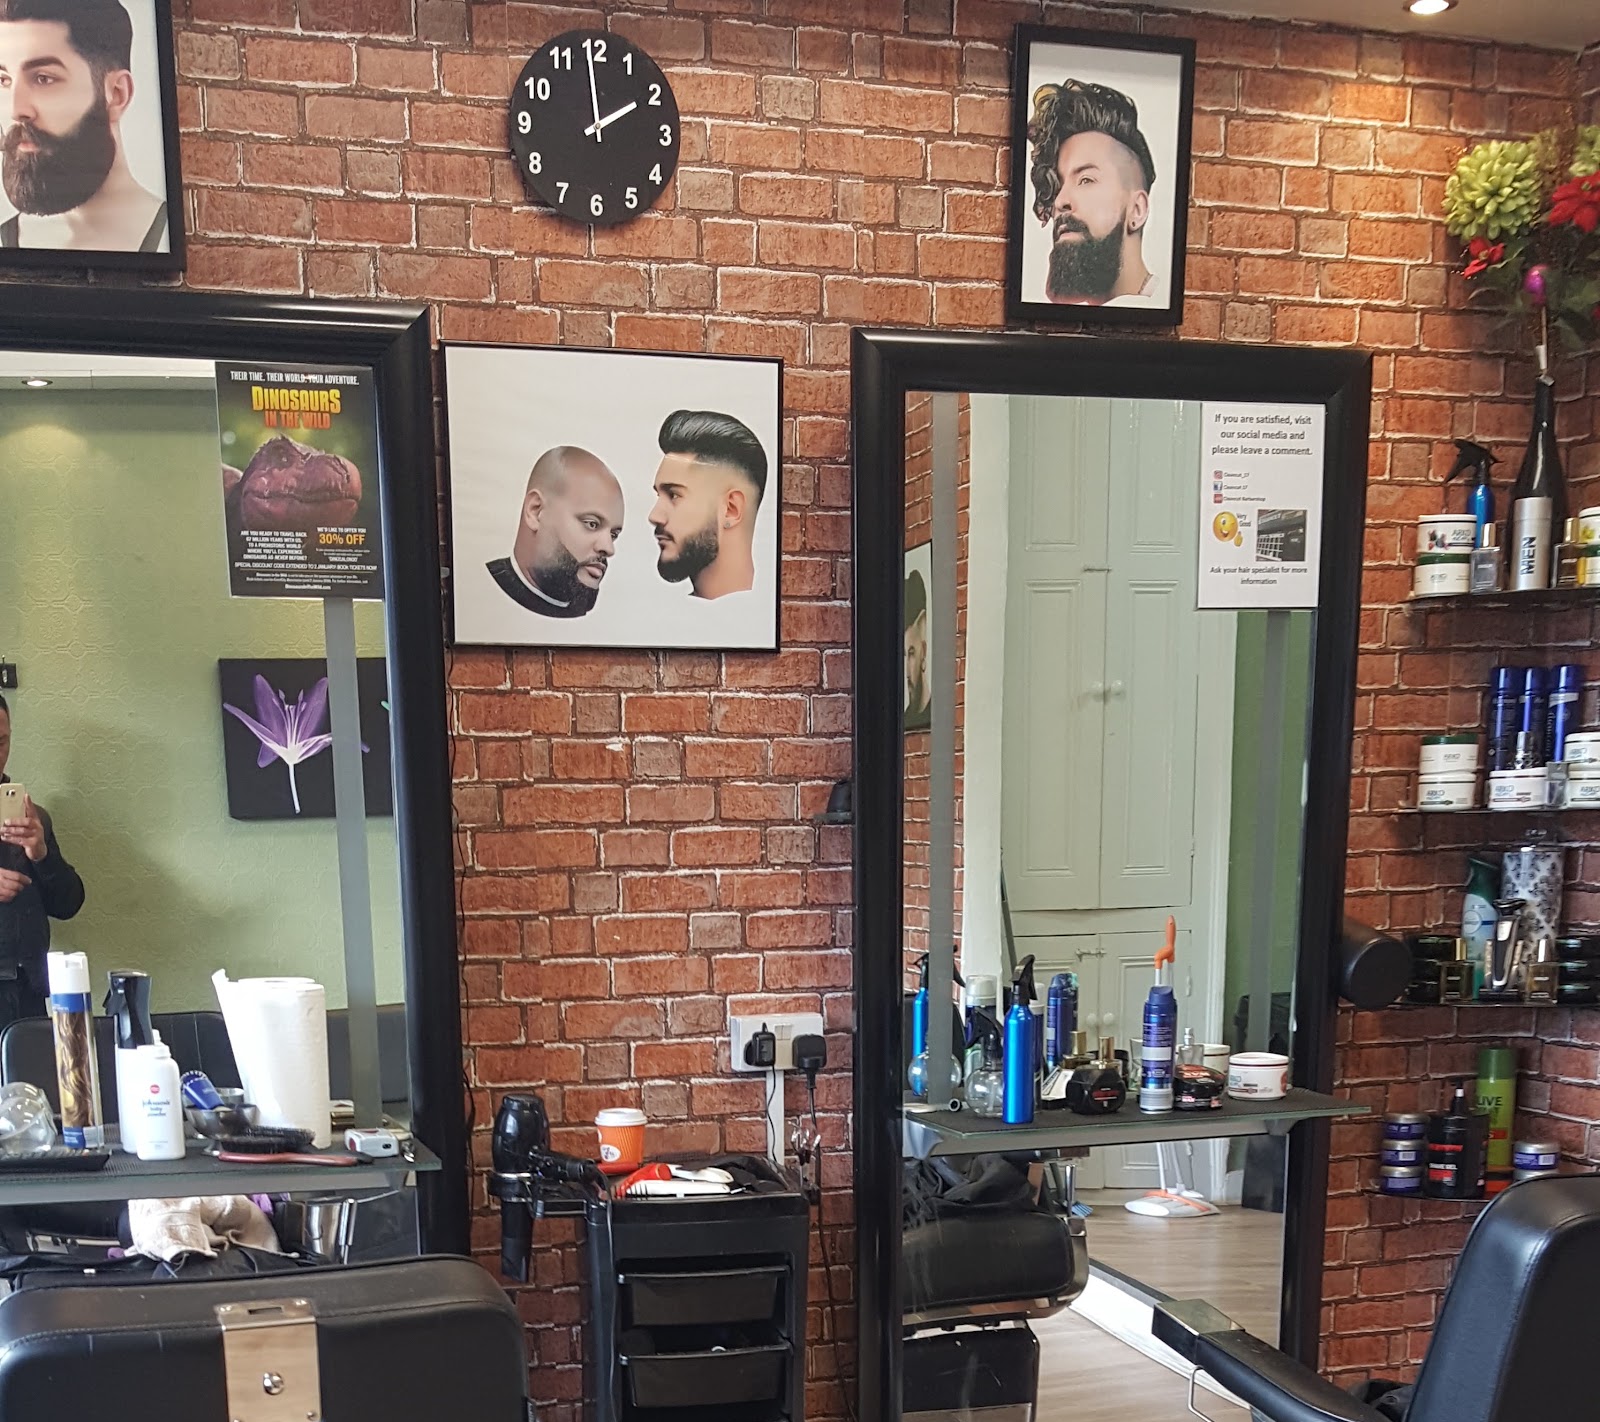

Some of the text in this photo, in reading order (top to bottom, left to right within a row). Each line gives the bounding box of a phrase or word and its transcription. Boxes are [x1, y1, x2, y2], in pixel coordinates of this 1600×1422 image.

[549, 46, 572, 70] 11
[581, 38, 607, 63] 12
[622, 53, 633, 75] 1
[525, 77, 550, 101] 10
[648, 84, 661, 106] 2
[517, 111, 532, 134] 9
[659, 125, 672, 146] 3
[528, 152, 542, 174] 8
[649, 164, 662, 185] 4
[556, 182, 569, 204] 7
[625, 187, 638, 209] 5
[590, 194, 603, 217] 6
[230, 371, 248, 380] THEIR
[248, 372, 265, 381] TIME.
[266, 372, 284, 382] THEIR
[324, 375, 359, 385] ADVENTURE.
[251, 385, 341, 414] DINOSAURS
[265, 410, 331, 429] IN THE WILD
[1214, 414, 1221, 422] If
[1223, 416, 1238, 424] you
[1256, 415, 1292, 426] satisfied,
[1295, 416, 1312, 424] visit
[1237, 430, 1260, 439] social
[1262, 431, 1288, 439] media
[1289, 431, 1305, 440] and
[1212, 445, 1238, 455] please
[1240, 445, 1262, 454] leave
[319, 533, 365, 545] 30% OFF
[1520, 537, 1537, 575] MEN
